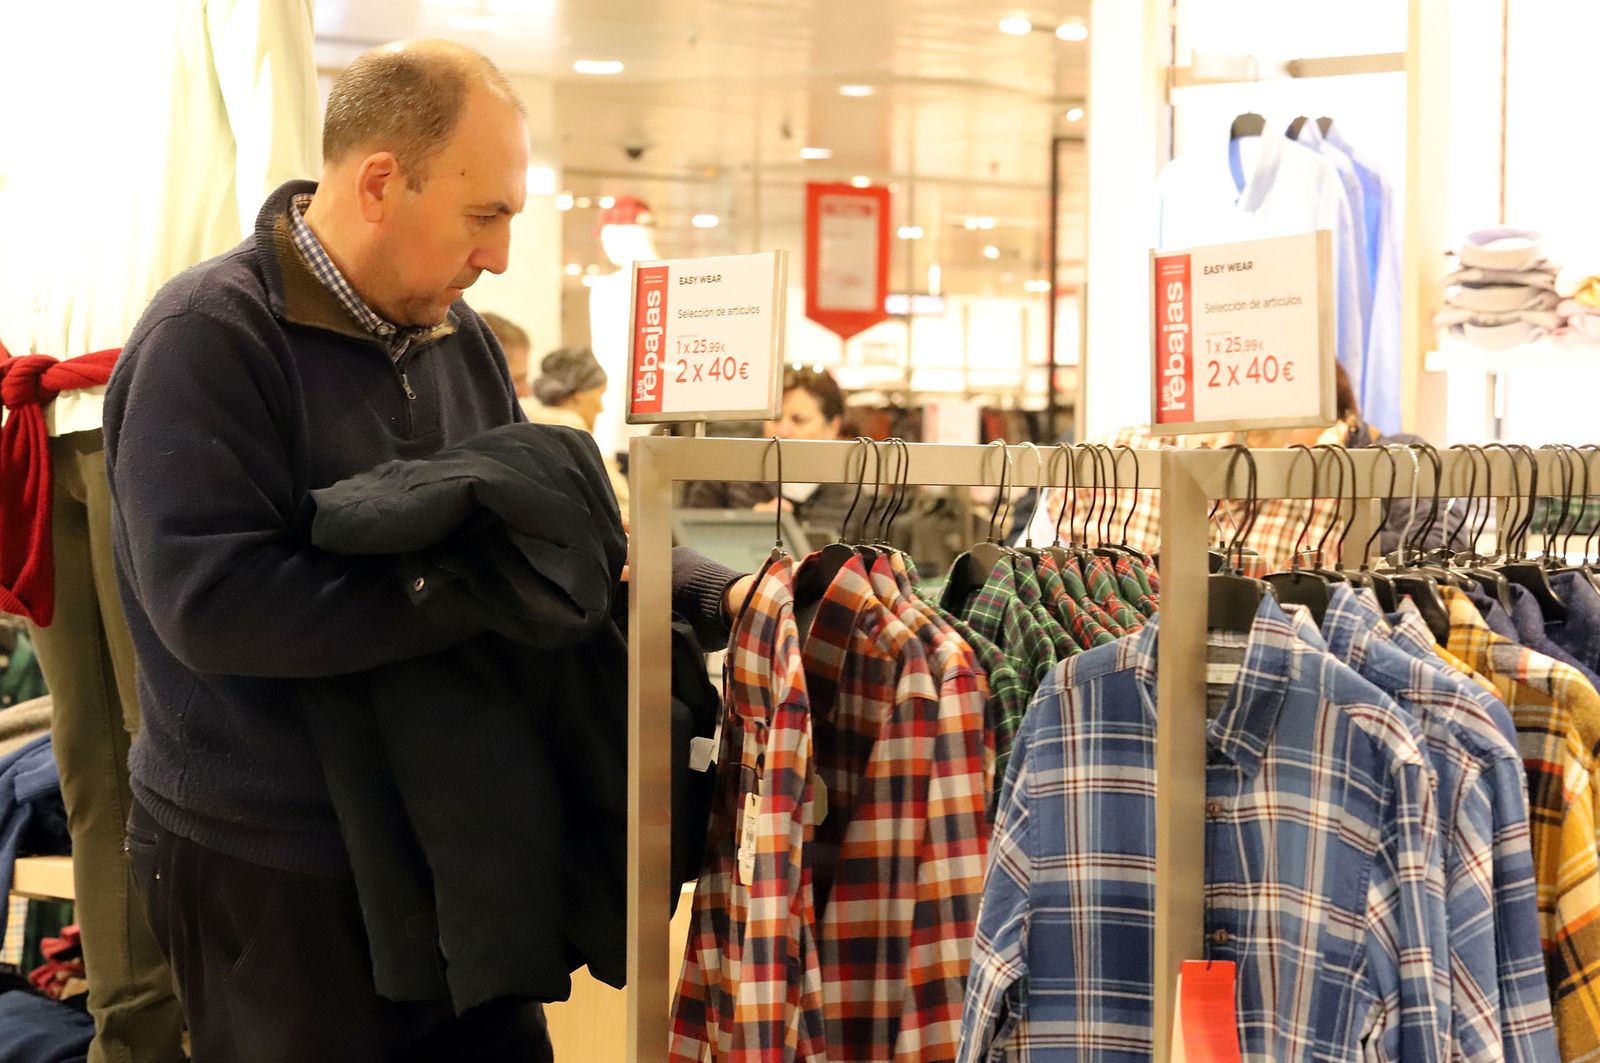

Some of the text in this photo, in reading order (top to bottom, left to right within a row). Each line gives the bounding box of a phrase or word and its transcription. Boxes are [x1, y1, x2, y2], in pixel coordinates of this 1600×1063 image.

[1203, 261, 1253, 275] EASY WEAR
[679, 274, 722, 285] EASY WEAR
[678, 308, 714, 319] Selección
[716, 306, 726, 316] de
[1204, 300, 1246, 314] Selección
[1249, 298, 1261, 309] de
[641, 290, 663, 401] rebajas
[677, 341, 681, 354] 1
[683, 343, 690, 354] x
[1164, 281, 1188, 411] rebajas
[1206, 339, 1211, 354] 1
[1214, 341, 1222, 354] x
[675, 356, 750, 383] 2 x 40€
[1207, 355, 1295, 388] 2 x 40€
